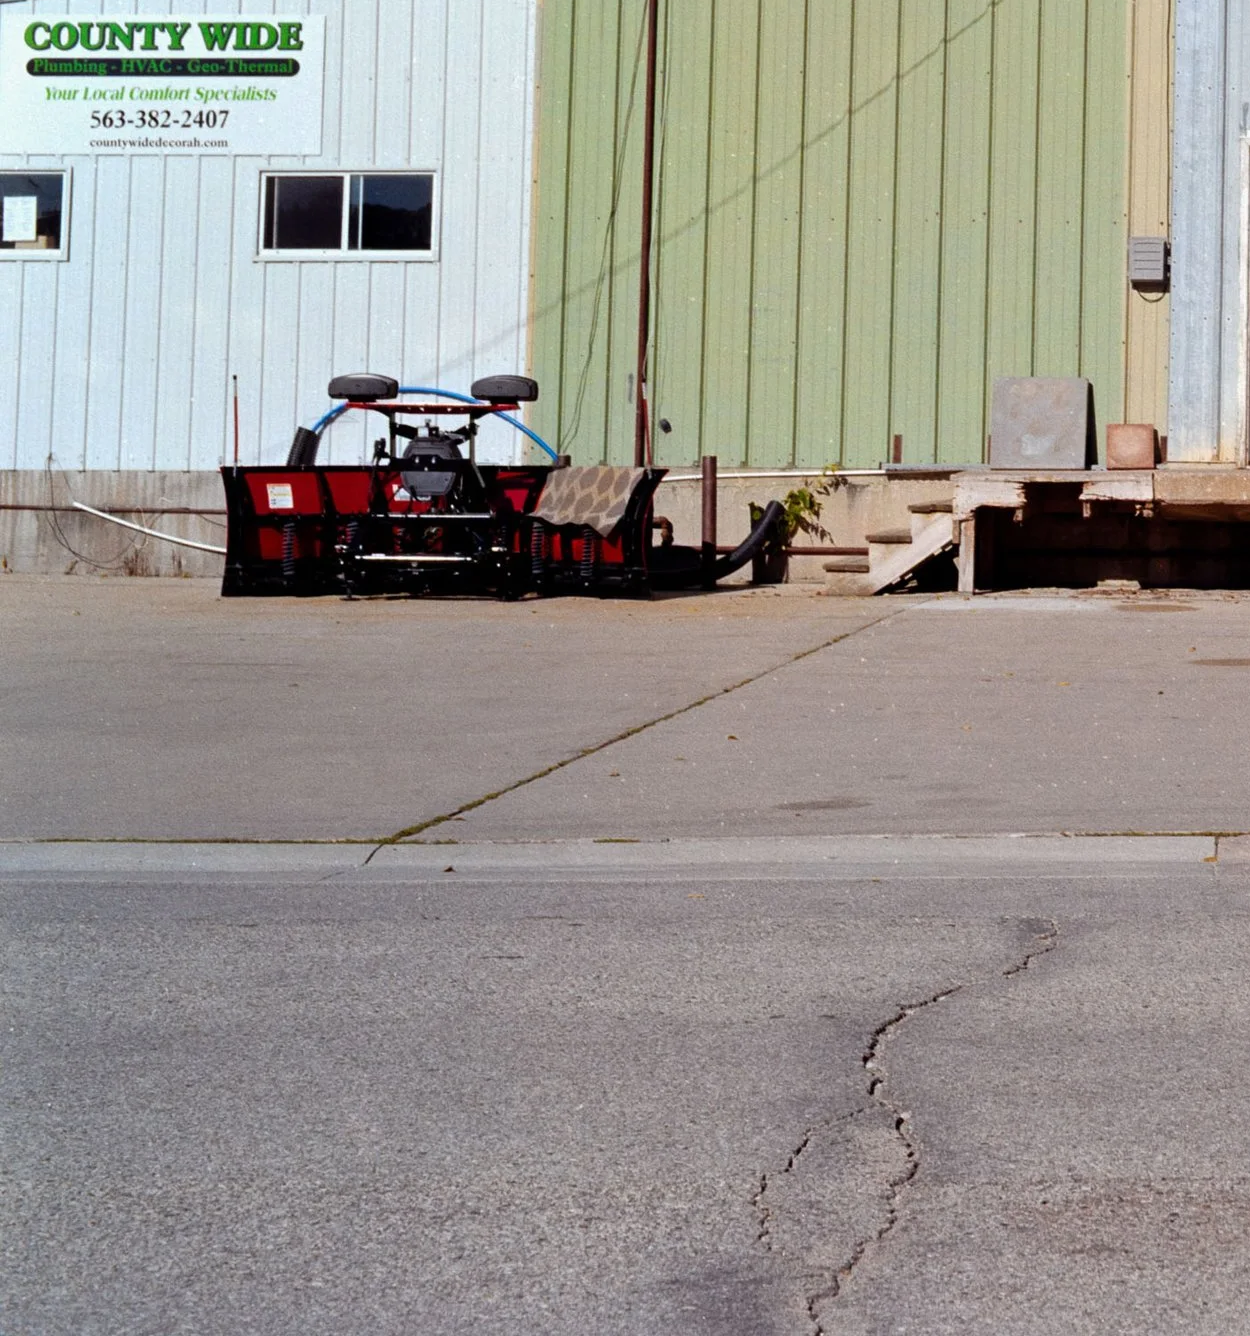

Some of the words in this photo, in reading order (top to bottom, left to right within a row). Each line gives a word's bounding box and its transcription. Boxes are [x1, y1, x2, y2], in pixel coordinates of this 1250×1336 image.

[24, 21, 191, 51] COUNTY
[198, 21, 304, 51] WIDE
[33, 58, 107, 75] Plumbing
[121, 59, 172, 73] HVAC
[187, 58, 293, 73] Geo-Thermal
[45, 85, 79, 101] Your
[83, 85, 126, 101] Local
[129, 85, 191, 101] Comfort
[193, 85, 278, 104] Specialists
[90, 110, 230, 129] 563-382-2407
[90, 137, 228, 149] countywidedecorah.com
